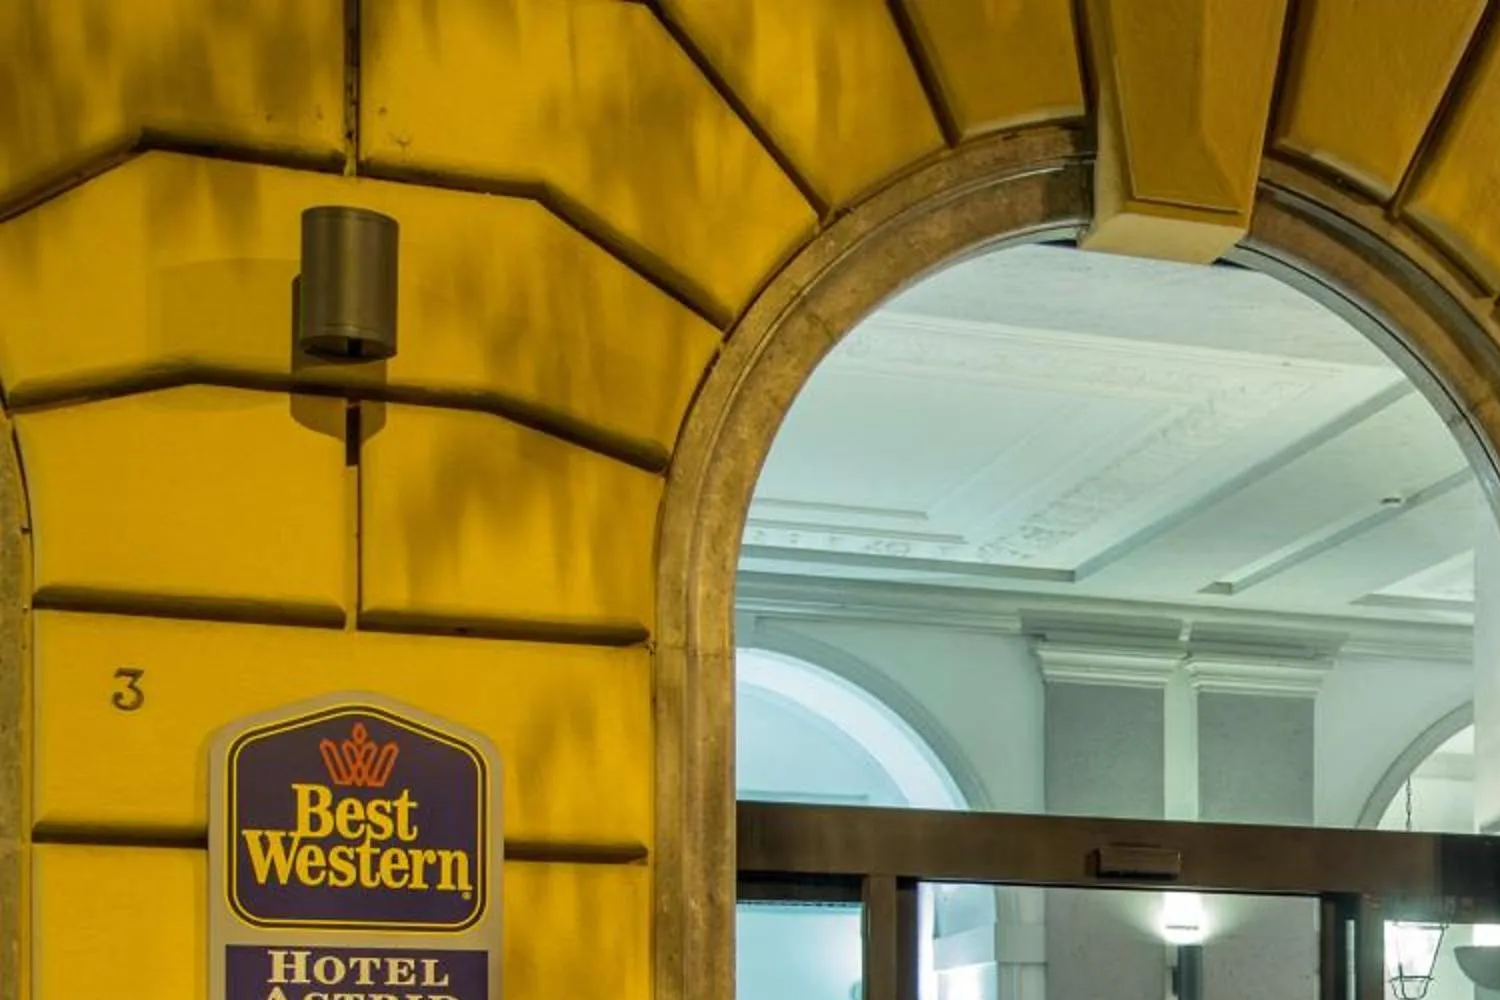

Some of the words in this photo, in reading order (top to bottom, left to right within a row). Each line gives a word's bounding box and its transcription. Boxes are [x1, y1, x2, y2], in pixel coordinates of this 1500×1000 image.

[110, 667, 146, 712] 3
[291, 783, 420, 843] Best
[241, 828, 474, 892] Western
[266, 949, 451, 988] HOTEL
